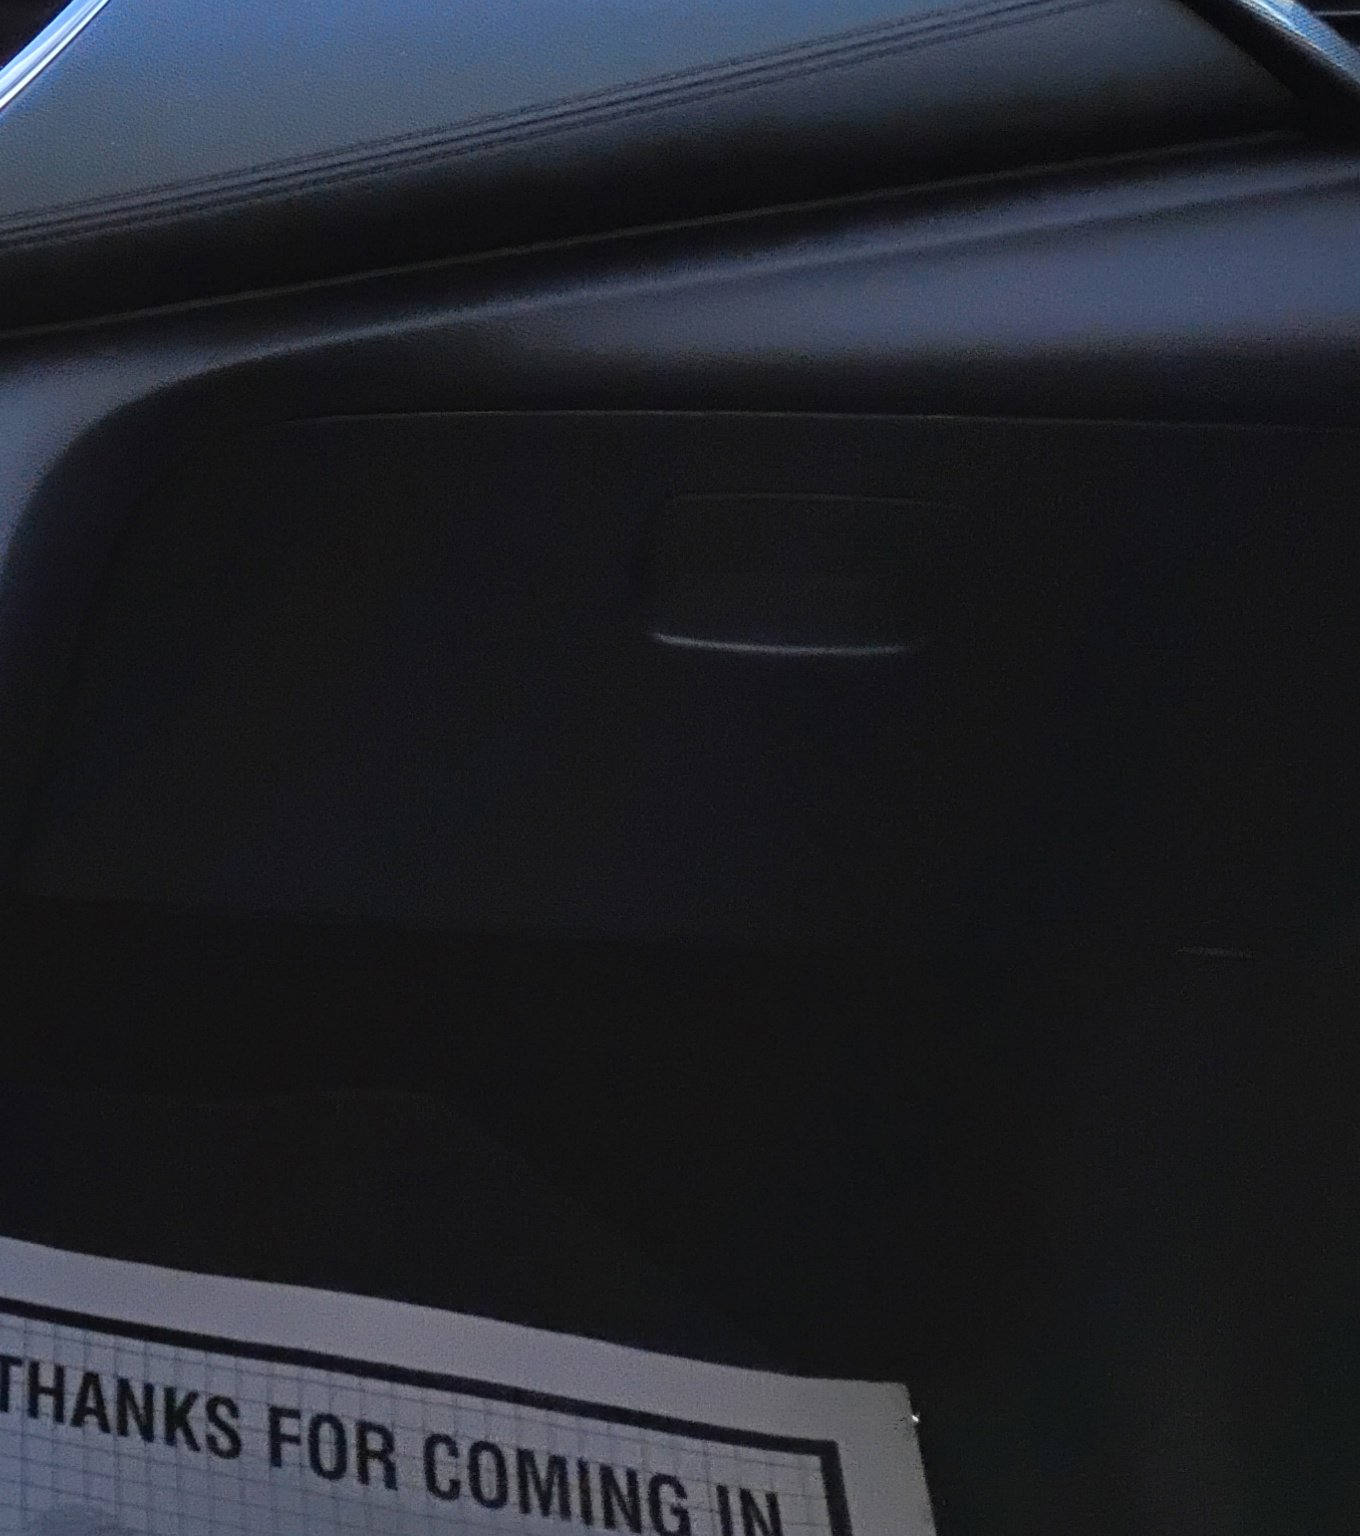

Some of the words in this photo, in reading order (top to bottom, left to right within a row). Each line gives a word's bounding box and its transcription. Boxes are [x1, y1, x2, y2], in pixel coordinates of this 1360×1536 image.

[265, 1406, 398, 1490] FOR
[422, 1433, 692, 1536] COMING
[715, 1483, 784, 1536] IN
